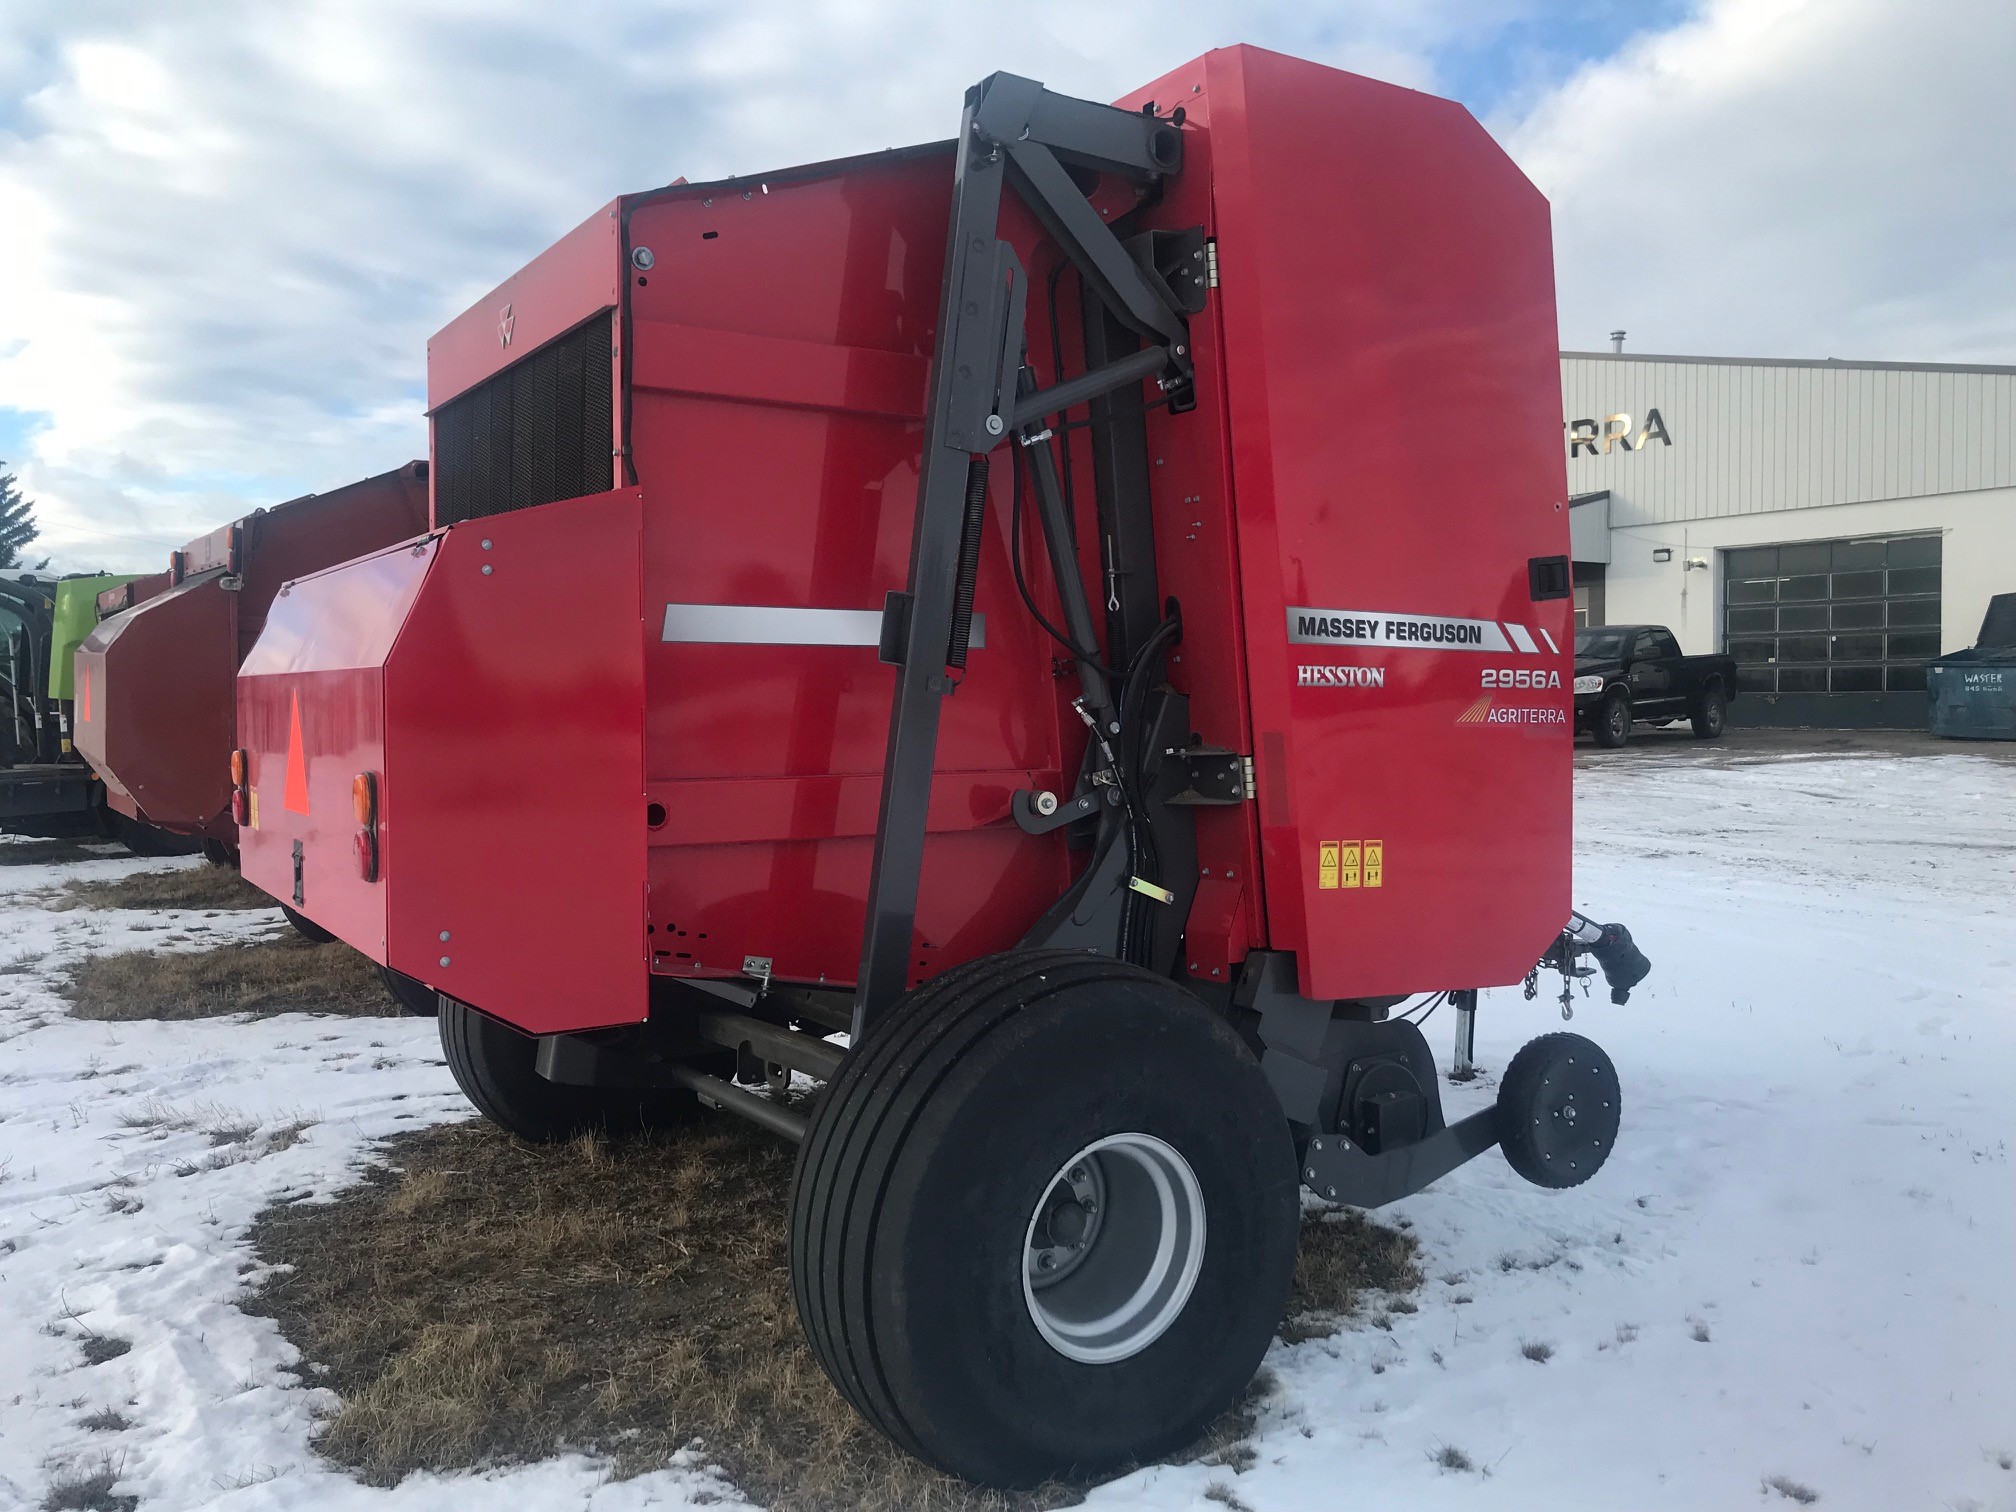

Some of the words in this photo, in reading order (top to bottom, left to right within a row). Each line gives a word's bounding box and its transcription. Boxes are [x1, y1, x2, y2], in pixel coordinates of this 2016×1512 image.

[1563, 408, 1672, 458] RRA
[1298, 616, 1379, 640] MASSEY
[1385, 620, 1482, 644] FERGUSON
[1297, 665, 1385, 688] HESSTON
[1481, 668, 1562, 689] 2956A
[1487, 708, 1566, 724] AGRITERRA
